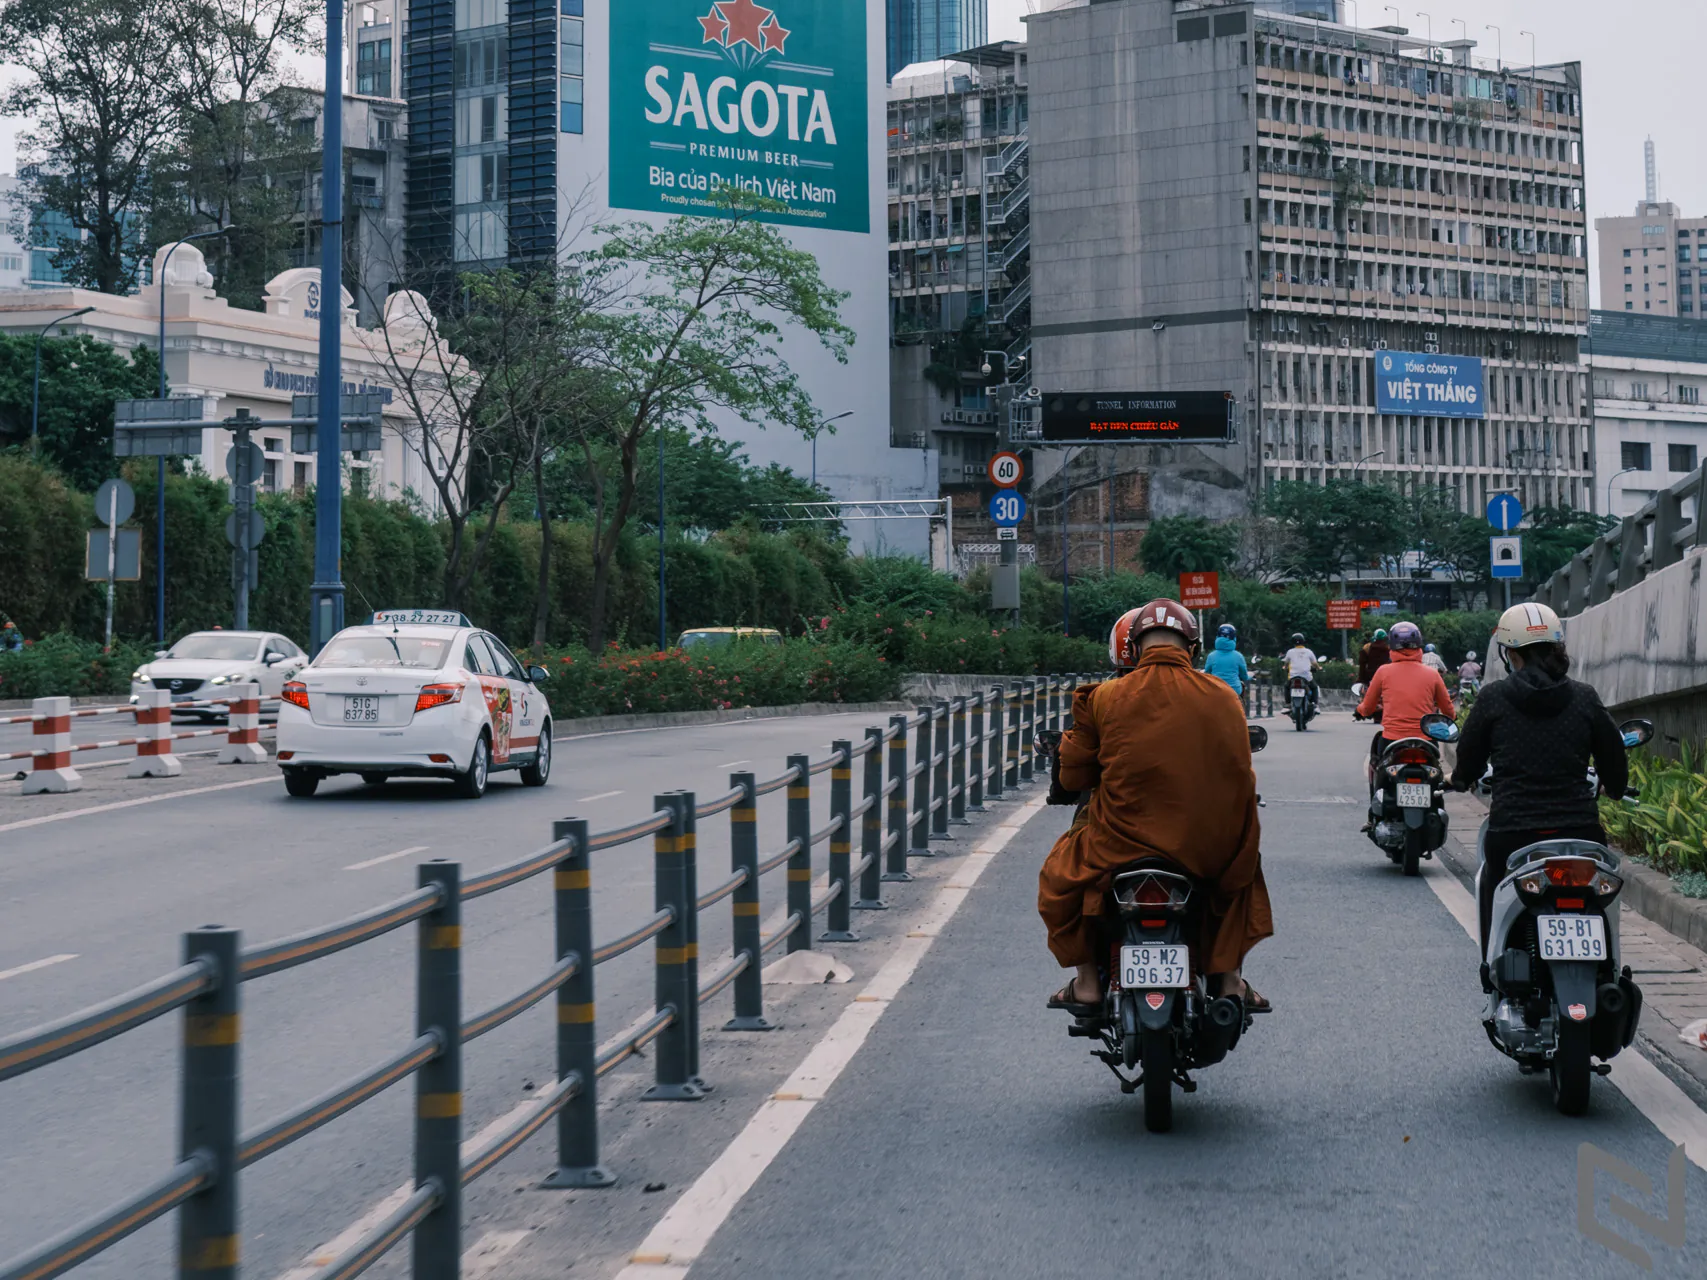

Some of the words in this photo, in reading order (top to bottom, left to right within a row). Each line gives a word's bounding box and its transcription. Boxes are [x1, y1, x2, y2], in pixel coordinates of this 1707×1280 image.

[644, 65, 837, 145] SAGOTA
[690, 142, 759, 162] PREMIUM
[765, 151, 799, 167] BEER
[650, 166, 675, 187] Bia
[679, 168, 707, 191] của
[766, 178, 799, 204] Việt
[802, 182, 836, 204] Nam
[661, 193, 689, 207] Proudly
[787, 207, 827, 219] Association
[1405, 359, 1425, 374] TỔNG
[1427, 362, 1448, 375] CÔNG
[1449, 366, 1458, 376] TY
[1387, 377, 1421, 404] VIỆT
[1425, 377, 1477, 404] THẮNG
[1096, 401, 1124, 410] TUNNEL
[1128, 400, 1177, 410] INFORMATION
[998, 461, 1014, 478] 60
[996, 497, 1019, 521] 30
[426, 615, 440, 623] 27
[442, 615, 456, 623] 27
[352, 698, 371, 709] 51G
[345, 709, 377, 721] 637.85
[1402, 785, 1424, 795] 59-E1
[1548, 919, 1592, 937] 59-B1
[1544, 939, 1602, 957] 631.99
[1132, 949, 1178, 966] 59-M2
[1126, 967, 1184, 985] 096.37
